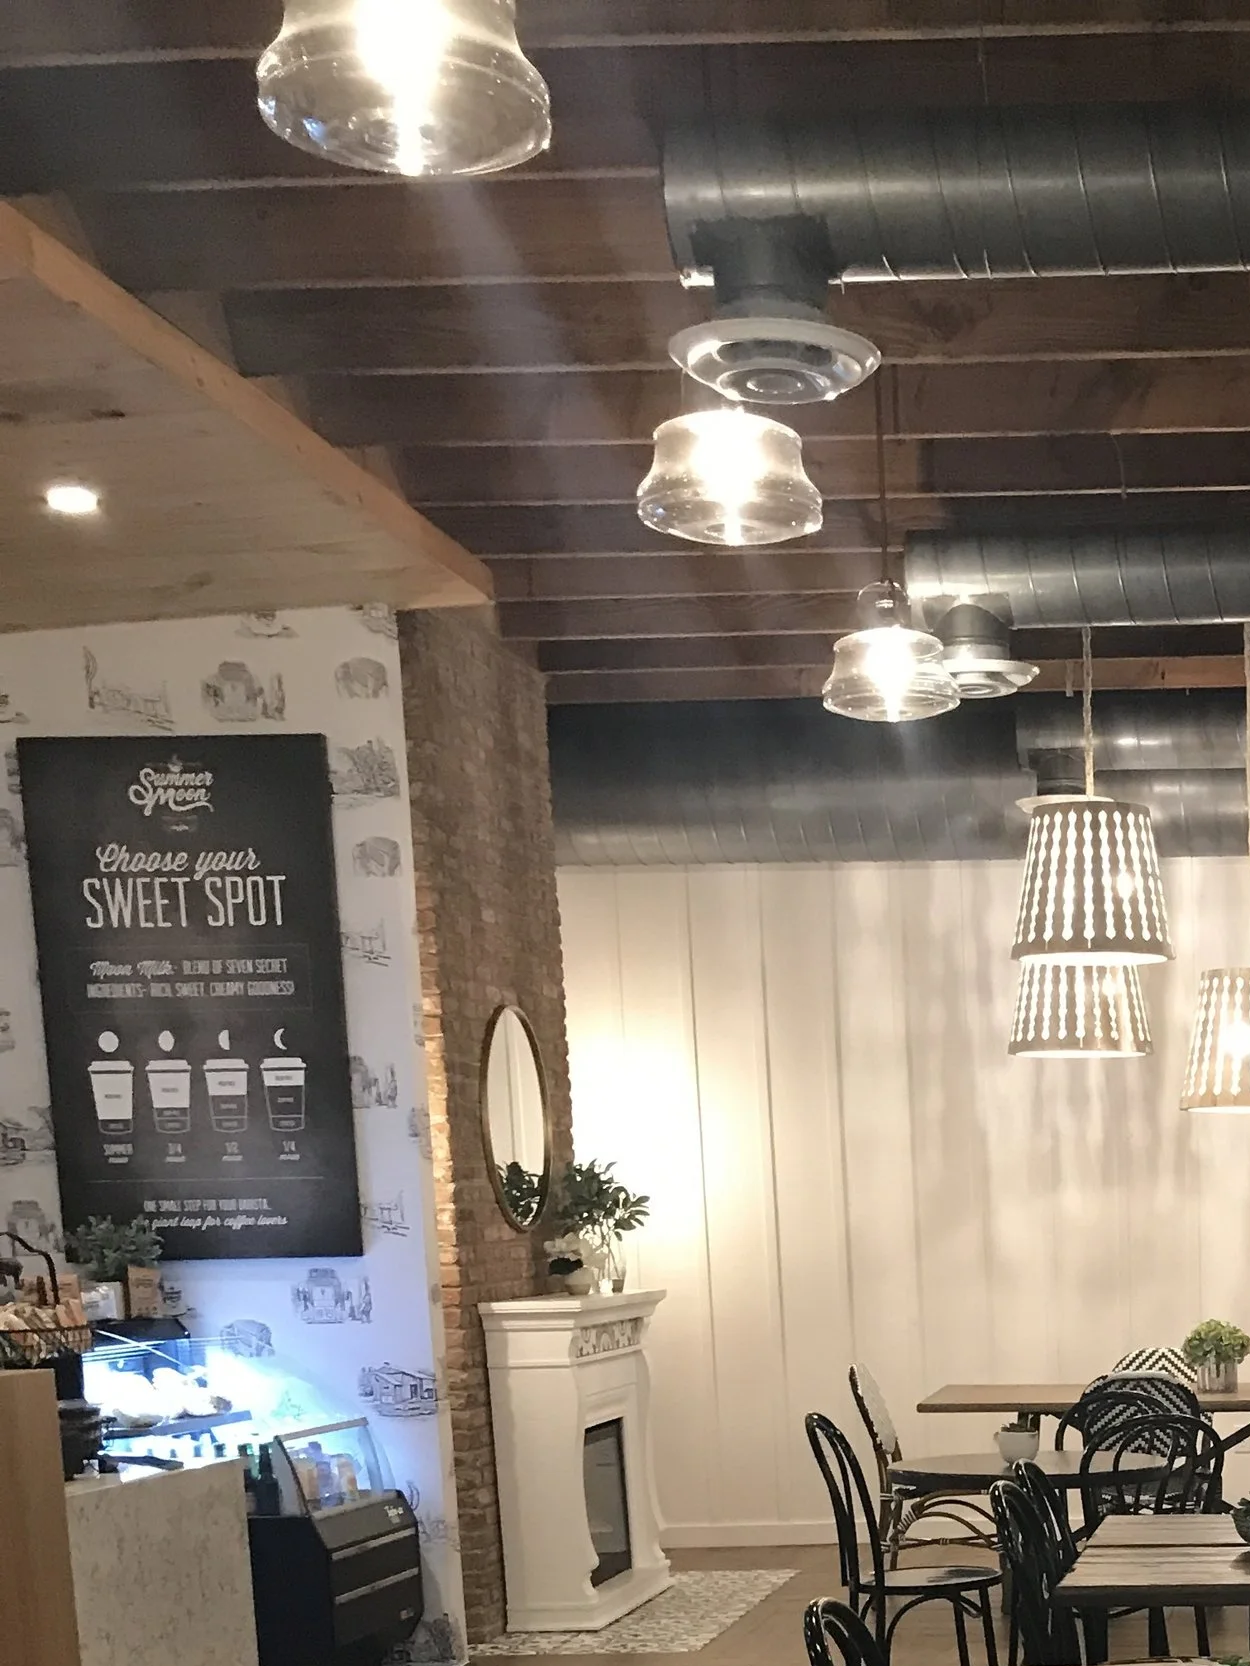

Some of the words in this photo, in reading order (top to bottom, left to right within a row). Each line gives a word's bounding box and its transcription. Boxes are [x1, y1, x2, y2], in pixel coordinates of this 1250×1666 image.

[129, 767, 214, 804] Summer
[143, 787, 215, 816] Moon
[95, 842, 189, 873] Choose
[193, 848, 261, 881] your
[82, 877, 191, 929] SWEET
[203, 874, 287, 927] SPOT
[225, 958, 253, 974] SEVEN
[255, 958, 288, 974] SECRET
[151, 1216, 179, 1231] giant
[179, 1215, 202, 1230] leap
[201, 1215, 222, 1231] for
[223, 1214, 257, 1230] coffee
[257, 1214, 289, 1226] lovers
